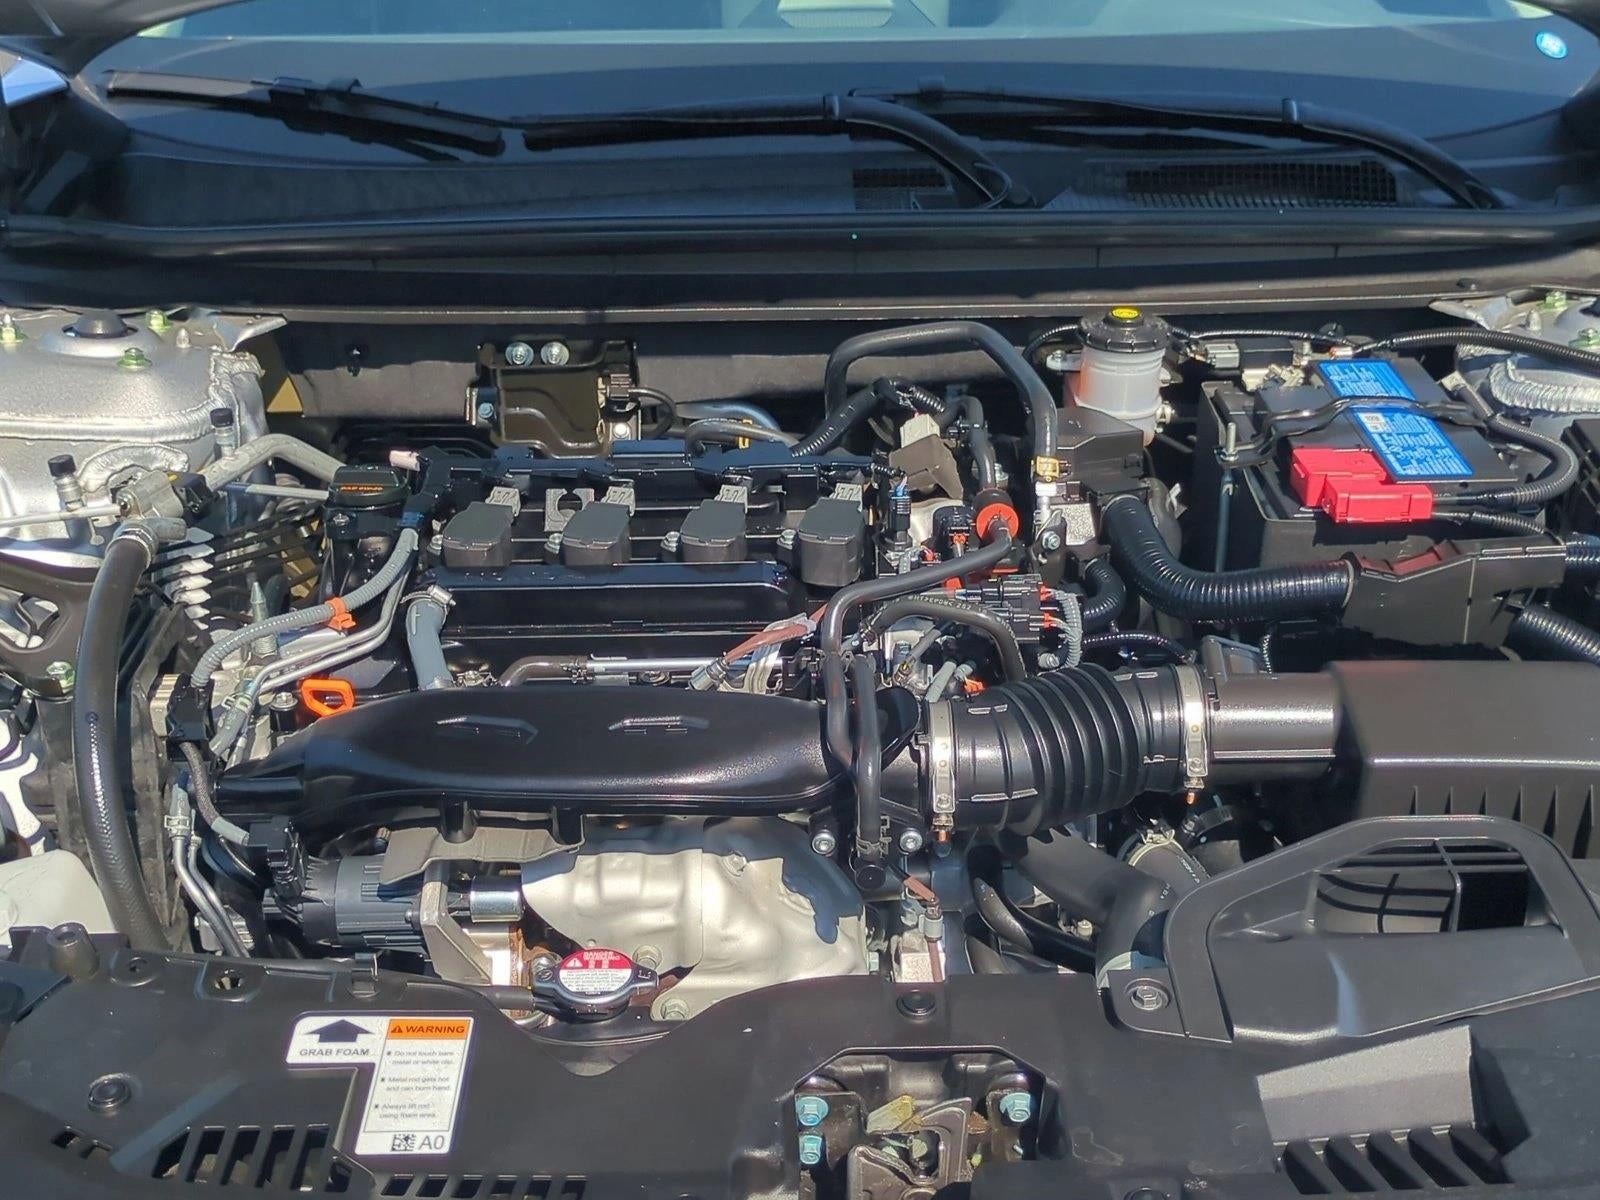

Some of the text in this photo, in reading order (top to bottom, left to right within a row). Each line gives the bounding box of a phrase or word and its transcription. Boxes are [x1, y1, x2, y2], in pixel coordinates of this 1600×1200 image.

[405, 1025, 465, 1034] WARNING
[300, 1048, 370, 1057] GRAB FOAM
